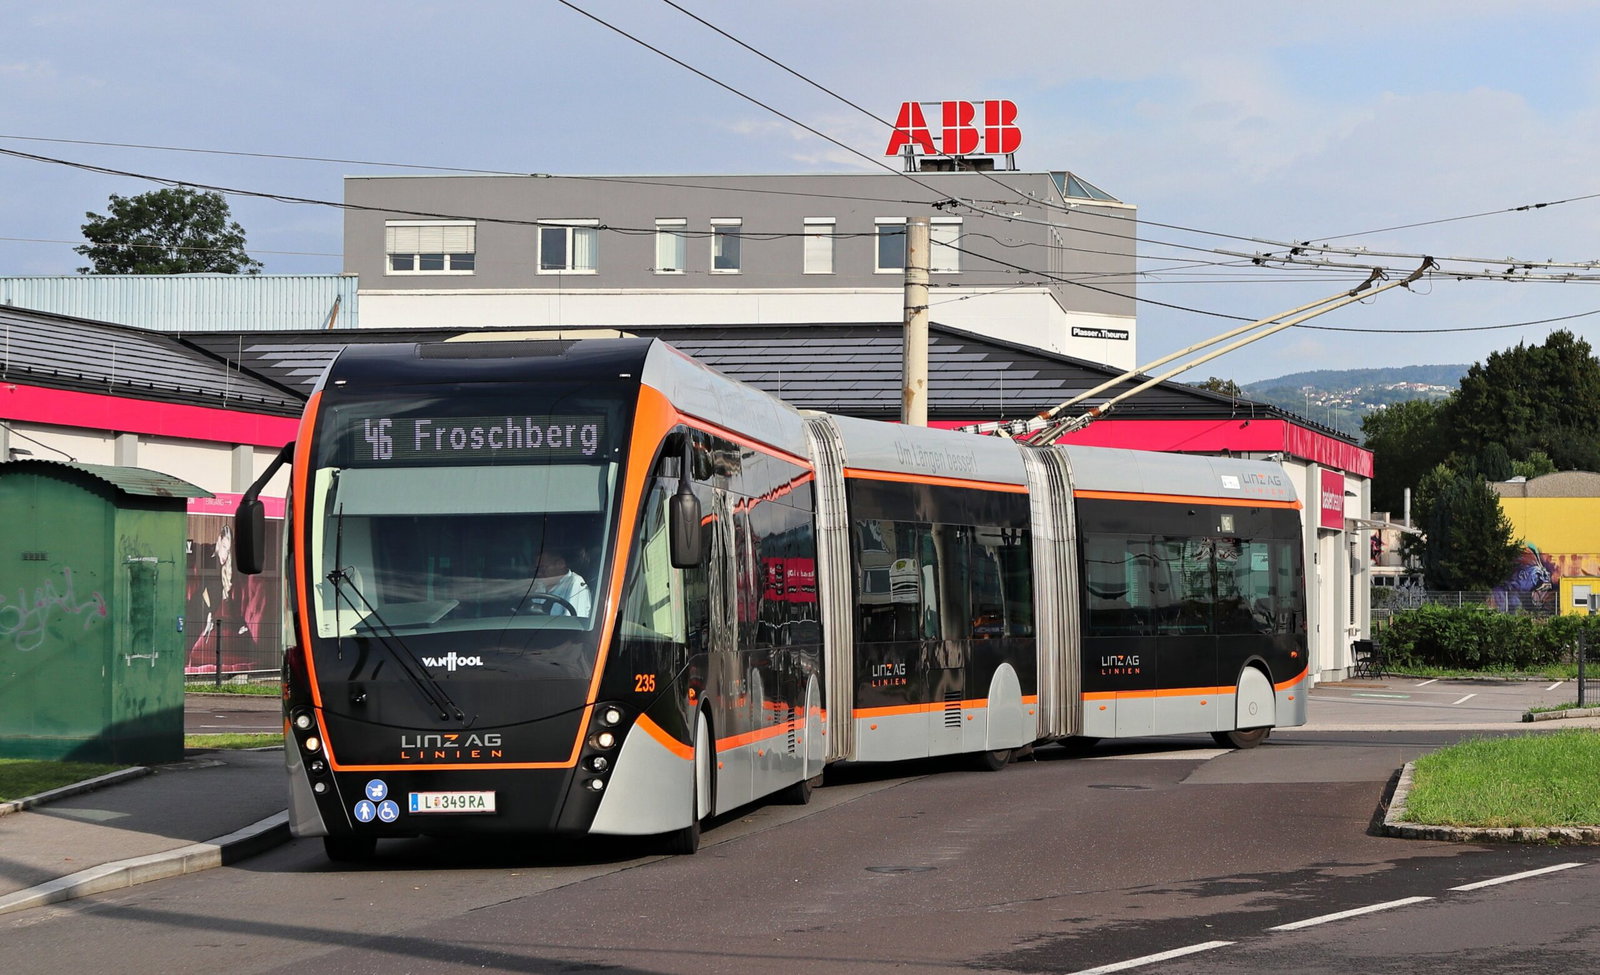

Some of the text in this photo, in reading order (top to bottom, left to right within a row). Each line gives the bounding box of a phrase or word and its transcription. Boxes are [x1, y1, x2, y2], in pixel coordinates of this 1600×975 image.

[884, 99, 1023, 156] ABB
[1073, 328, 1098, 337] Plasser
[1102, 329, 1128, 339] Theurer
[364, 417, 598, 460] 46 Froschberg
[894, 440, 978, 474] Um Längen besser!
[1241, 473, 1266, 485] LINZ
[1267, 475, 1282, 486] AG
[1101, 654, 1140, 667] LINZ AG
[872, 663, 906, 677] LINZ AG
[1101, 667, 1140, 675] LINIEN
[635, 673, 655, 693] 235
[871, 677, 907, 687] LINIEN
[401, 733, 502, 747] LINZ AG
[401, 749, 502, 759] LINIEN
